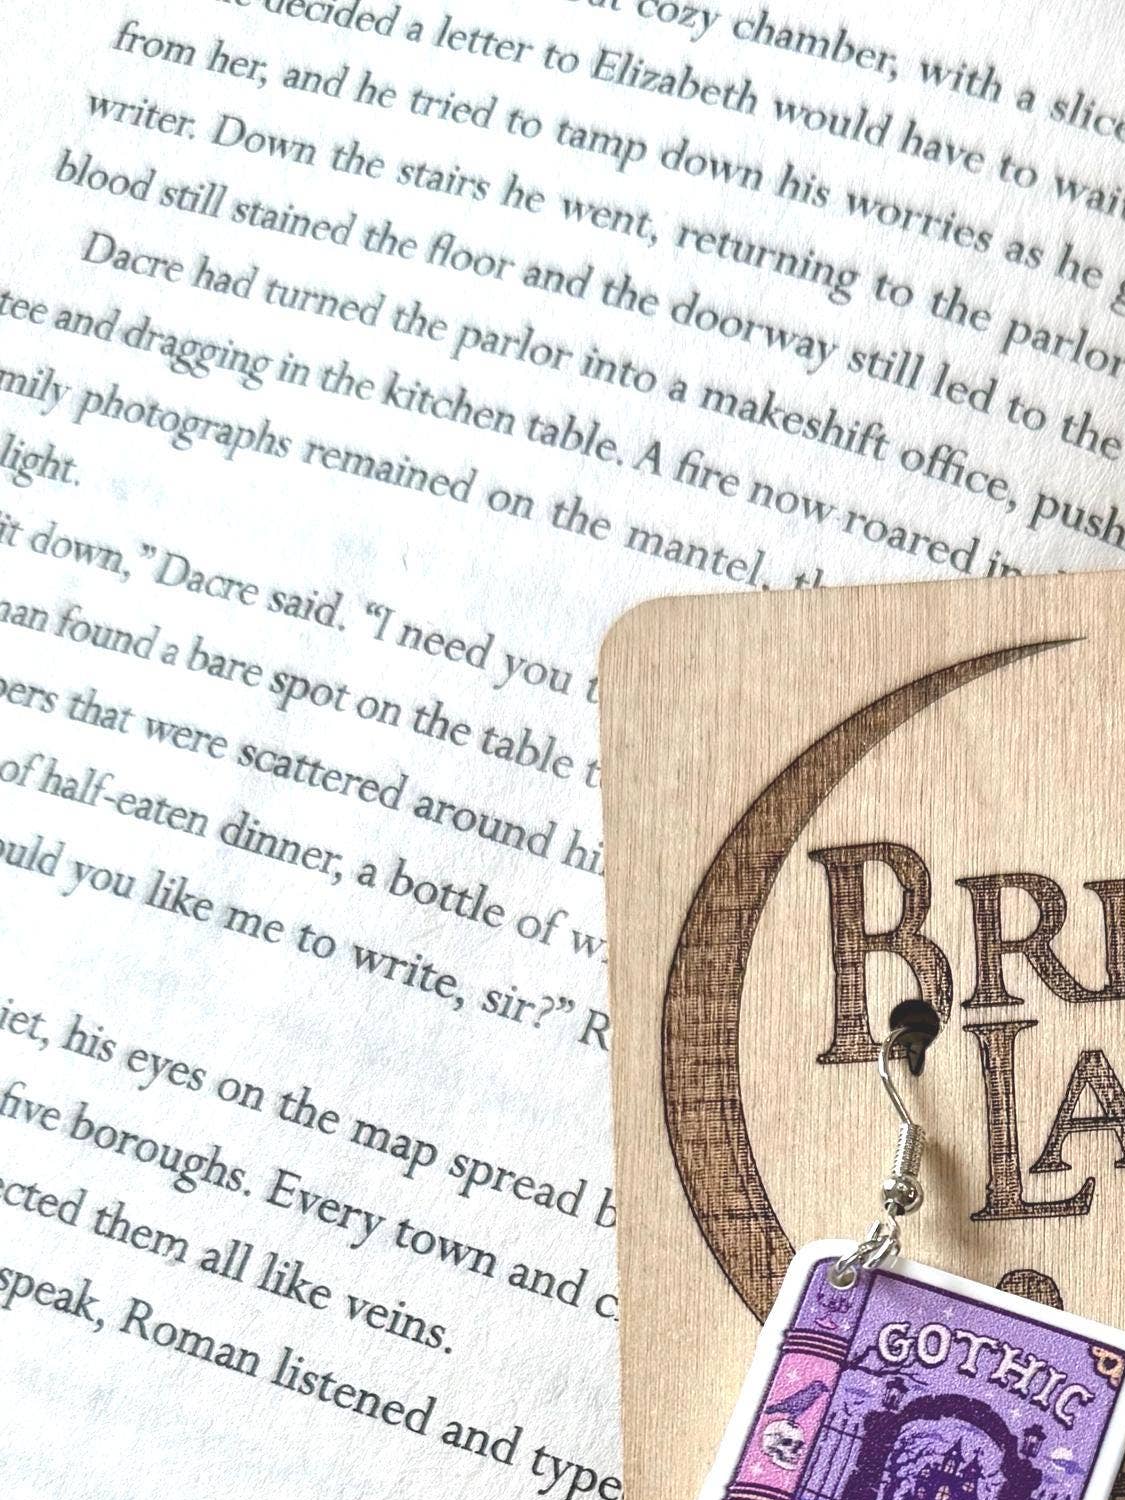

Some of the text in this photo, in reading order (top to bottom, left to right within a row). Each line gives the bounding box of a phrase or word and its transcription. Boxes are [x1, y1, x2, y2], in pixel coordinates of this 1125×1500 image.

[113, 20, 196, 65] from
[207, 39, 267, 86] her,
[283, 65, 349, 97] and
[355, 70, 396, 107] he
[411, 90, 498, 128] tried
[507, 109, 542, 137] to
[557, 120, 647, 172] tamp
[661, 137, 763, 190] down
[777, 161, 830, 206] his
[847, 192, 993, 251] worries
[1005, 240, 1044, 267] as
[1055, 242, 1102, 287] he
[406, 22, 423, 42] a
[435, 14, 533, 62] letter
[544, 44, 579, 72] to
[591, 48, 757, 114] Elizabeth
[774, 98, 893, 146] would
[900, 118, 984, 171] have
[1000, 154, 1037, 186] to
[82, 230, 1016, 512] Dacre had turned the parlor into a makeshift office,
[61, 1014, 587, 1217] his eyes on the map spread
[92, 1201, 452, 1354] them all like veins.
[119, 1297, 523, 1466] Roman listened and
[877, 1321, 1096, 1427] GOTHIC
